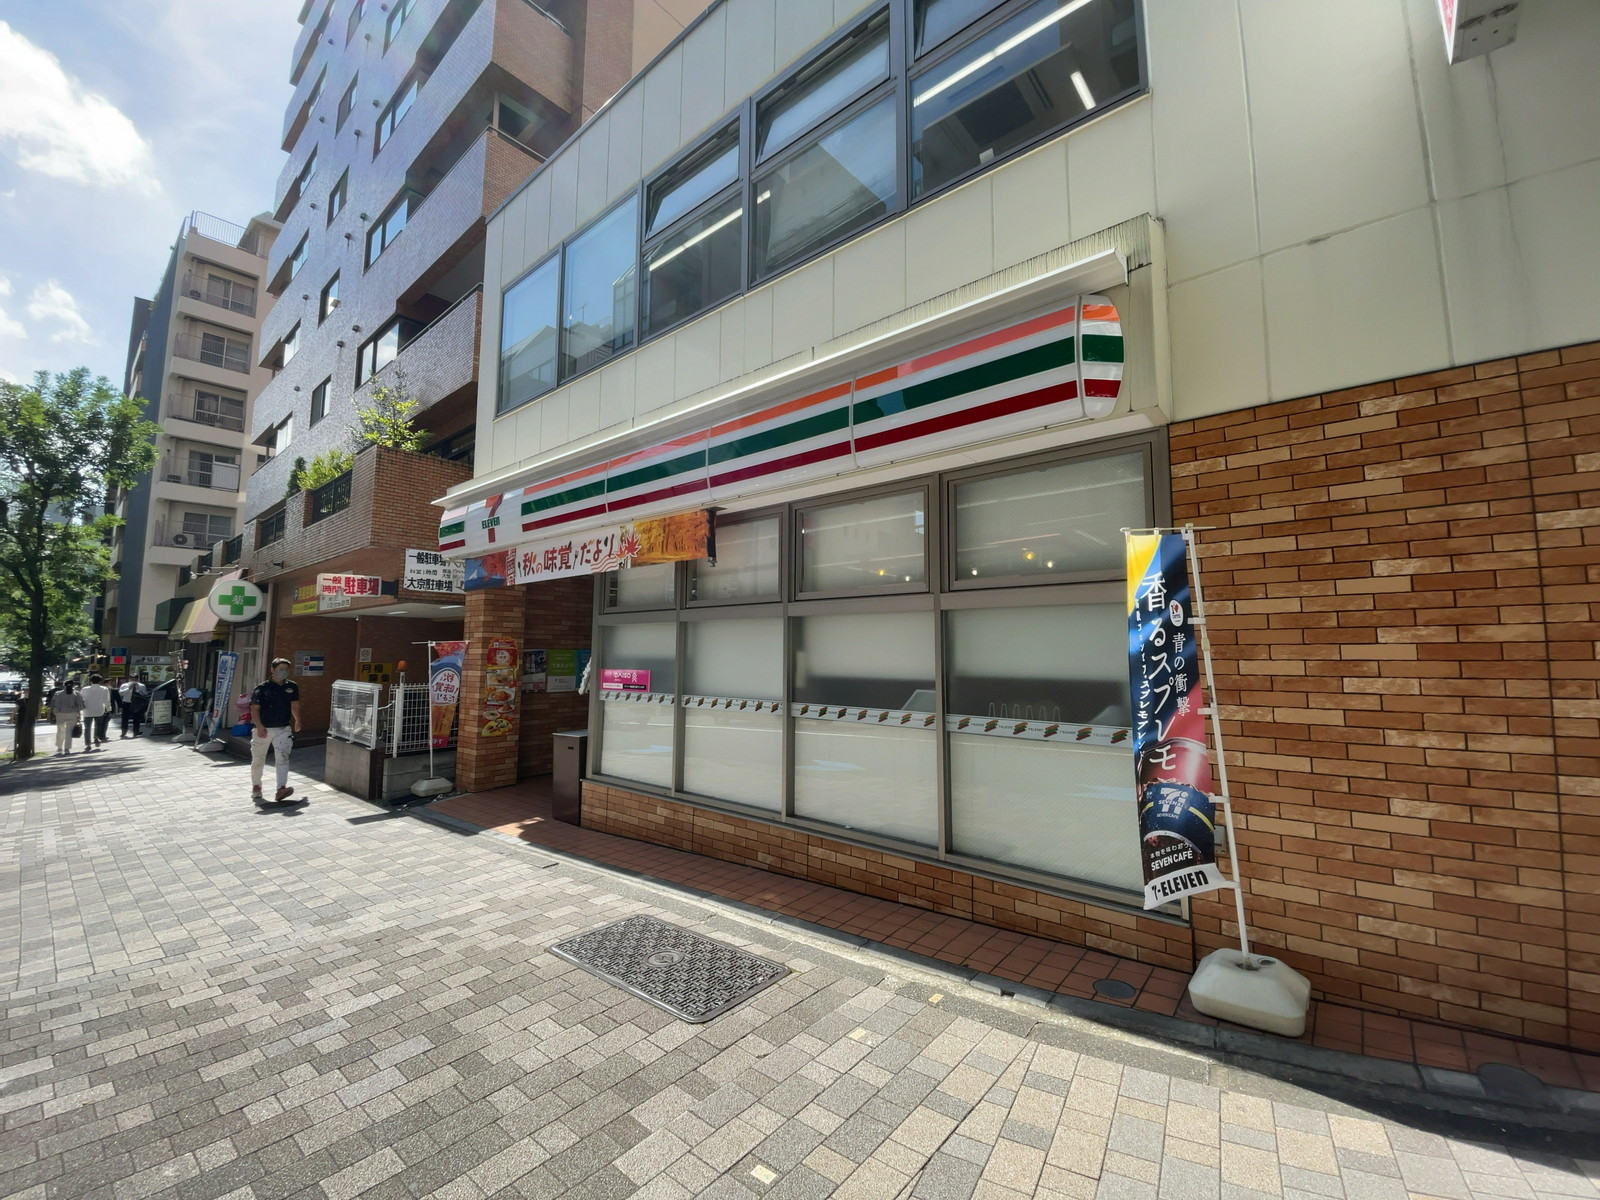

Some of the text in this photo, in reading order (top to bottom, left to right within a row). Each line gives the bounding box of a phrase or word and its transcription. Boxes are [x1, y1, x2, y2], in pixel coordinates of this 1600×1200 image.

[485, 492, 503, 543] 7
[522, 534, 615, 577] 秋の味覚だより
[323, 576, 379, 595] 一般 駐車場
[407, 577, 453, 592] 大京駐車場
[1141, 572, 1176, 770] 香るスプレモ
[1172, 632, 1191, 717] 青の衝撃
[1151, 848, 1194, 871] SEVEN CAFÉ
